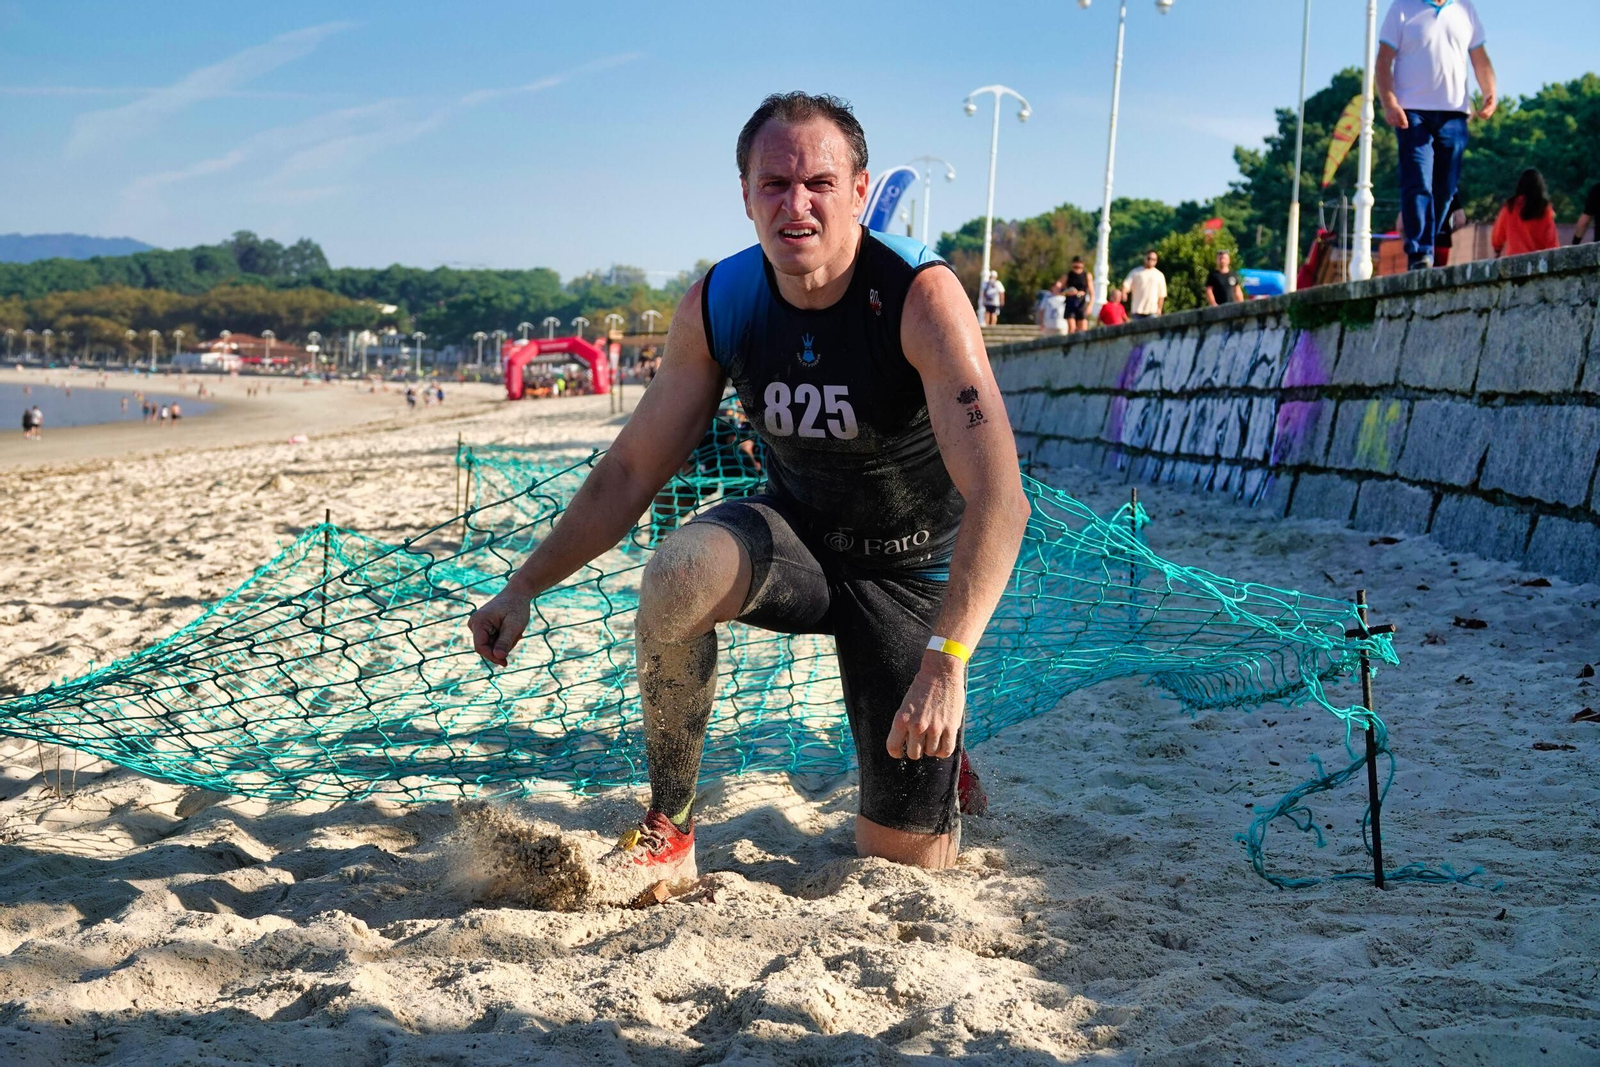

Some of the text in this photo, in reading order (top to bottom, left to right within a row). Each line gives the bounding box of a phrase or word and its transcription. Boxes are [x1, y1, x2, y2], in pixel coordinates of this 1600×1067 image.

[764, 381, 859, 440] 825
[967, 410, 983, 423] 28
[864, 530, 930, 555] Faro
